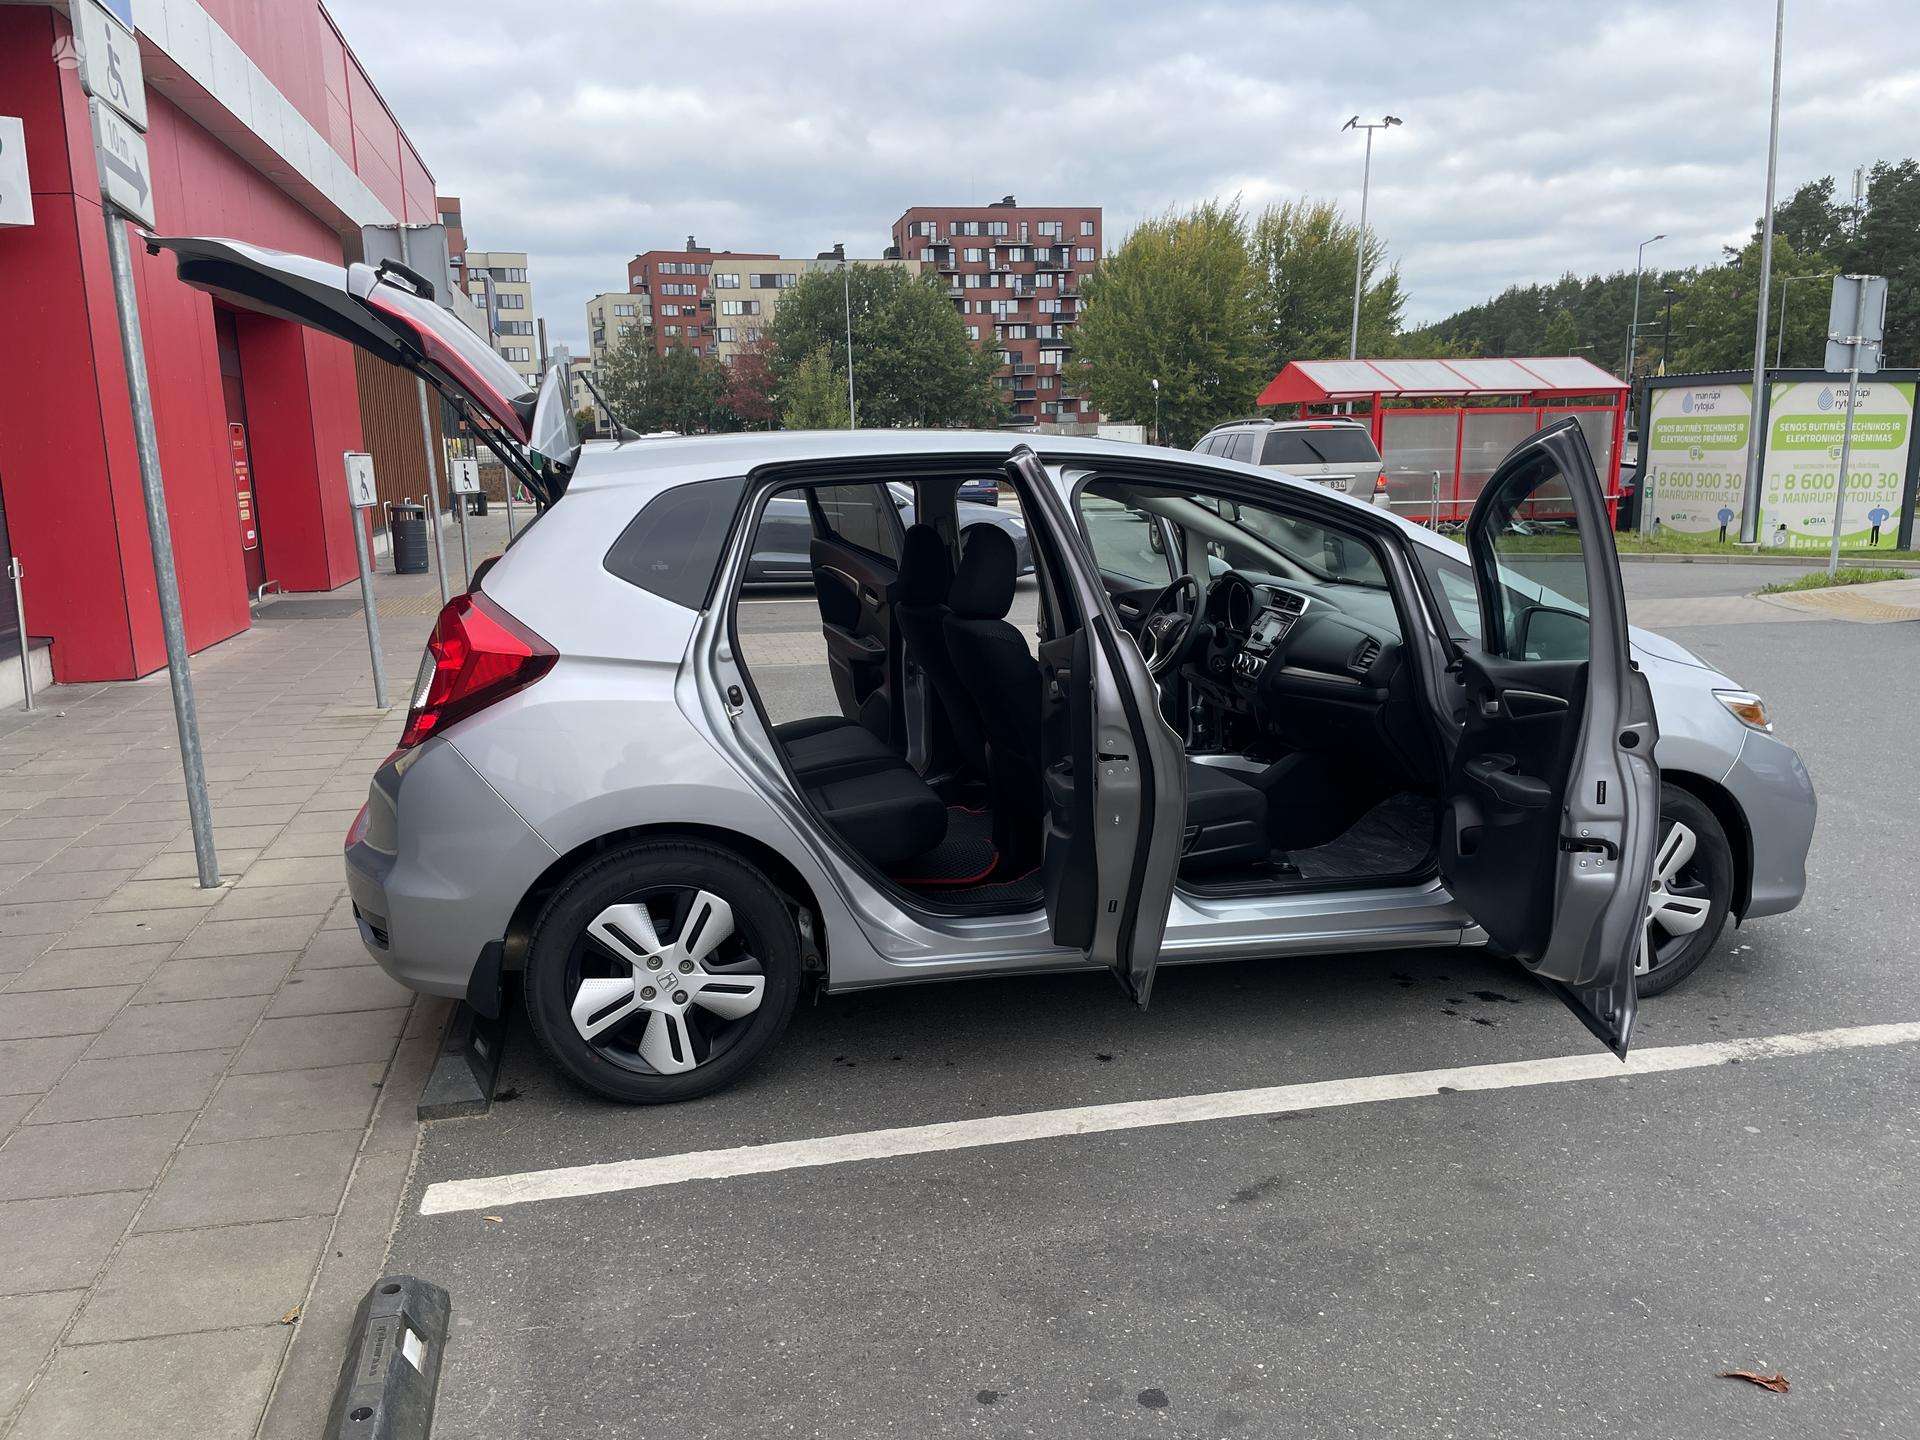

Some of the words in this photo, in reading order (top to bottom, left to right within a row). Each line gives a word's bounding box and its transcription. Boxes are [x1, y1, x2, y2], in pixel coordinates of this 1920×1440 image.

[1694, 402, 1715, 412] rytojus
[1834, 399, 1863, 410] rytus
[1780, 423, 1806, 432] SENOS
[1851, 422, 1891, 431] ECHNIKOS
[1892, 422, 1901, 430] IR
[1659, 472, 1666, 486] 8
[1670, 472, 1693, 488] 600
[1695, 472, 1722, 489] 900
[1724, 474, 1742, 490] 30
[1784, 472, 1796, 490] 8
[1800, 472, 1835, 490] 600
[1876, 472, 1898, 489] 30
[1782, 492, 1896, 504] MANRUPIYTOJUS.LT
